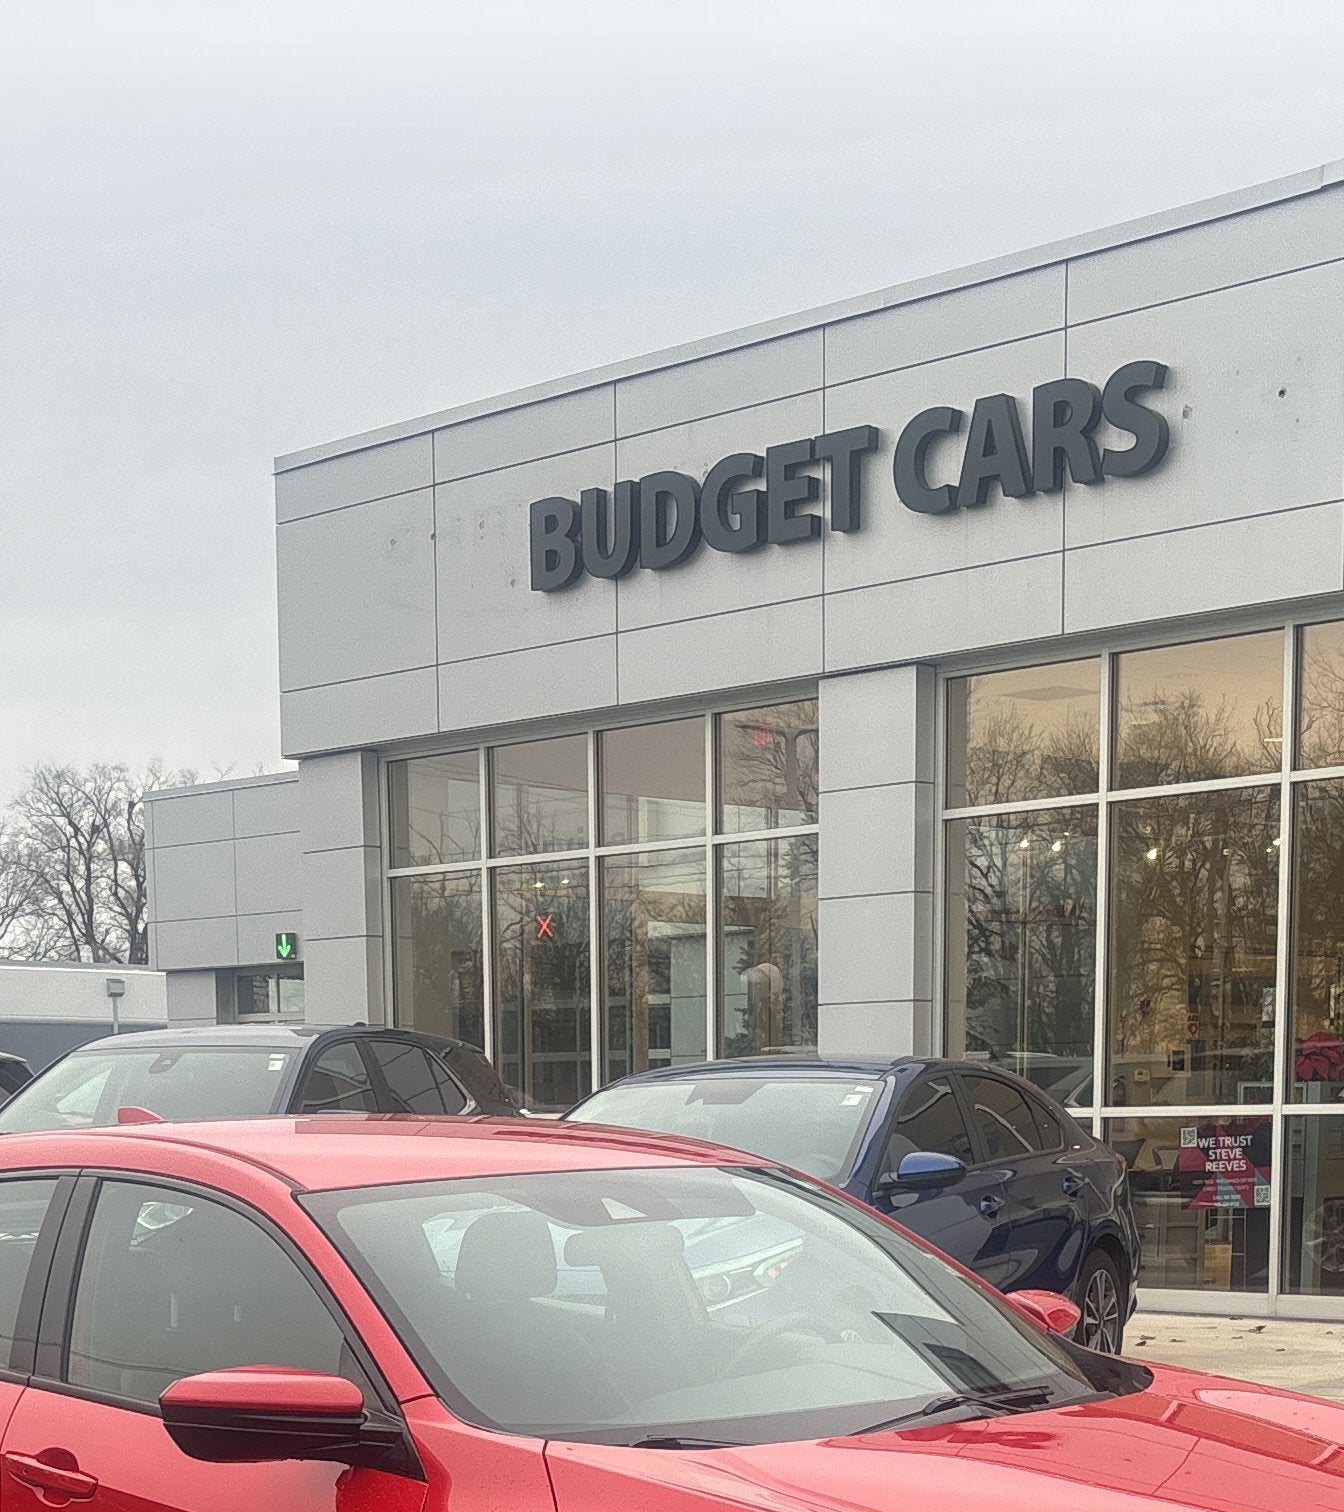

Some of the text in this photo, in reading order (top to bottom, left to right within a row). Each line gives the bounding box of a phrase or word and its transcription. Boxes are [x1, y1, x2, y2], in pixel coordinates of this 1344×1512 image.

[529, 360, 1169, 593] BUDGET CARS
[1197, 1135, 1254, 1149] WE TRUST
[1208, 1148, 1243, 1160] STEVE
[1205, 1160, 1247, 1173] REEVES
